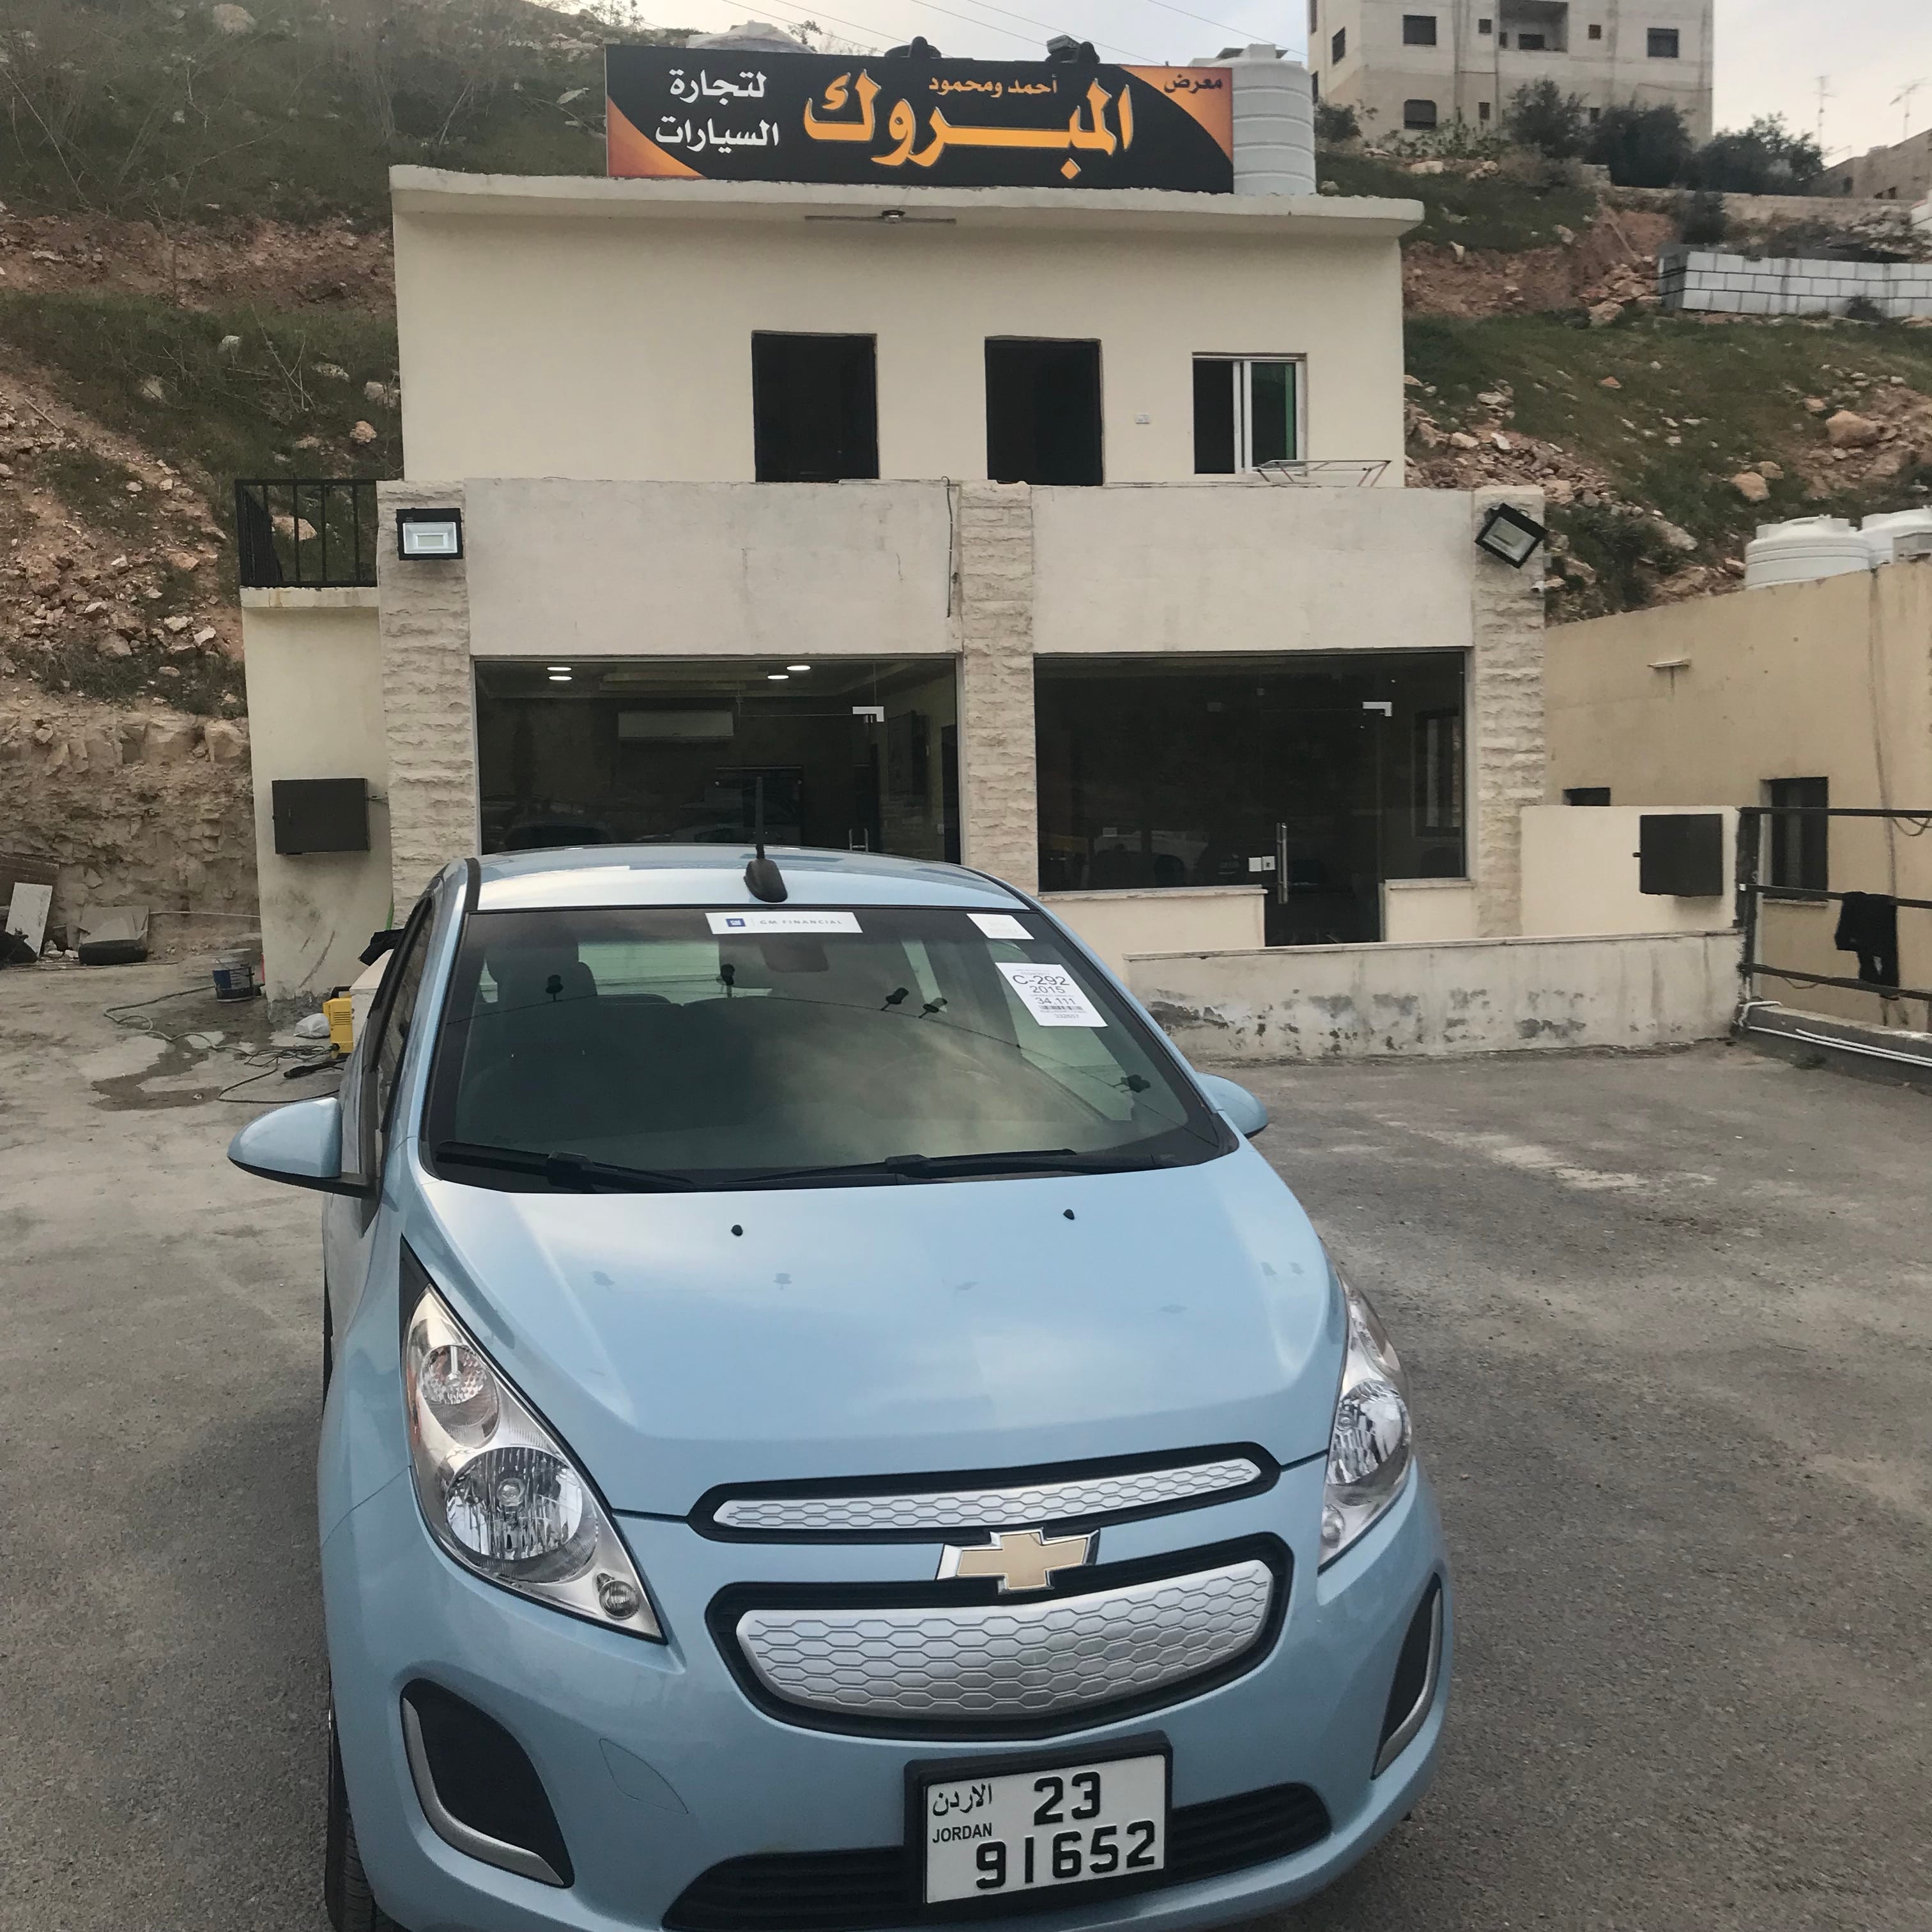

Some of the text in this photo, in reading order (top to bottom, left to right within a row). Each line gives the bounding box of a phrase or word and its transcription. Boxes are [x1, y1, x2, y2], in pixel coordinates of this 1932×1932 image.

[669, 68, 767, 105] لتجارة
[929, 73, 1057, 98] أحمد ومحمود
[1164, 73, 1223, 94] معرض
[656, 116, 779, 153] السيارات
[803, 68, 1133, 180] المبروك
[1013, 975, 1070, 985] C-292
[932, 1782, 993, 1816] الاردن
[1034, 1771, 1101, 1826] 23
[932, 1822, 993, 1843] JORDAN
[976, 1820, 1156, 1889] 91652
